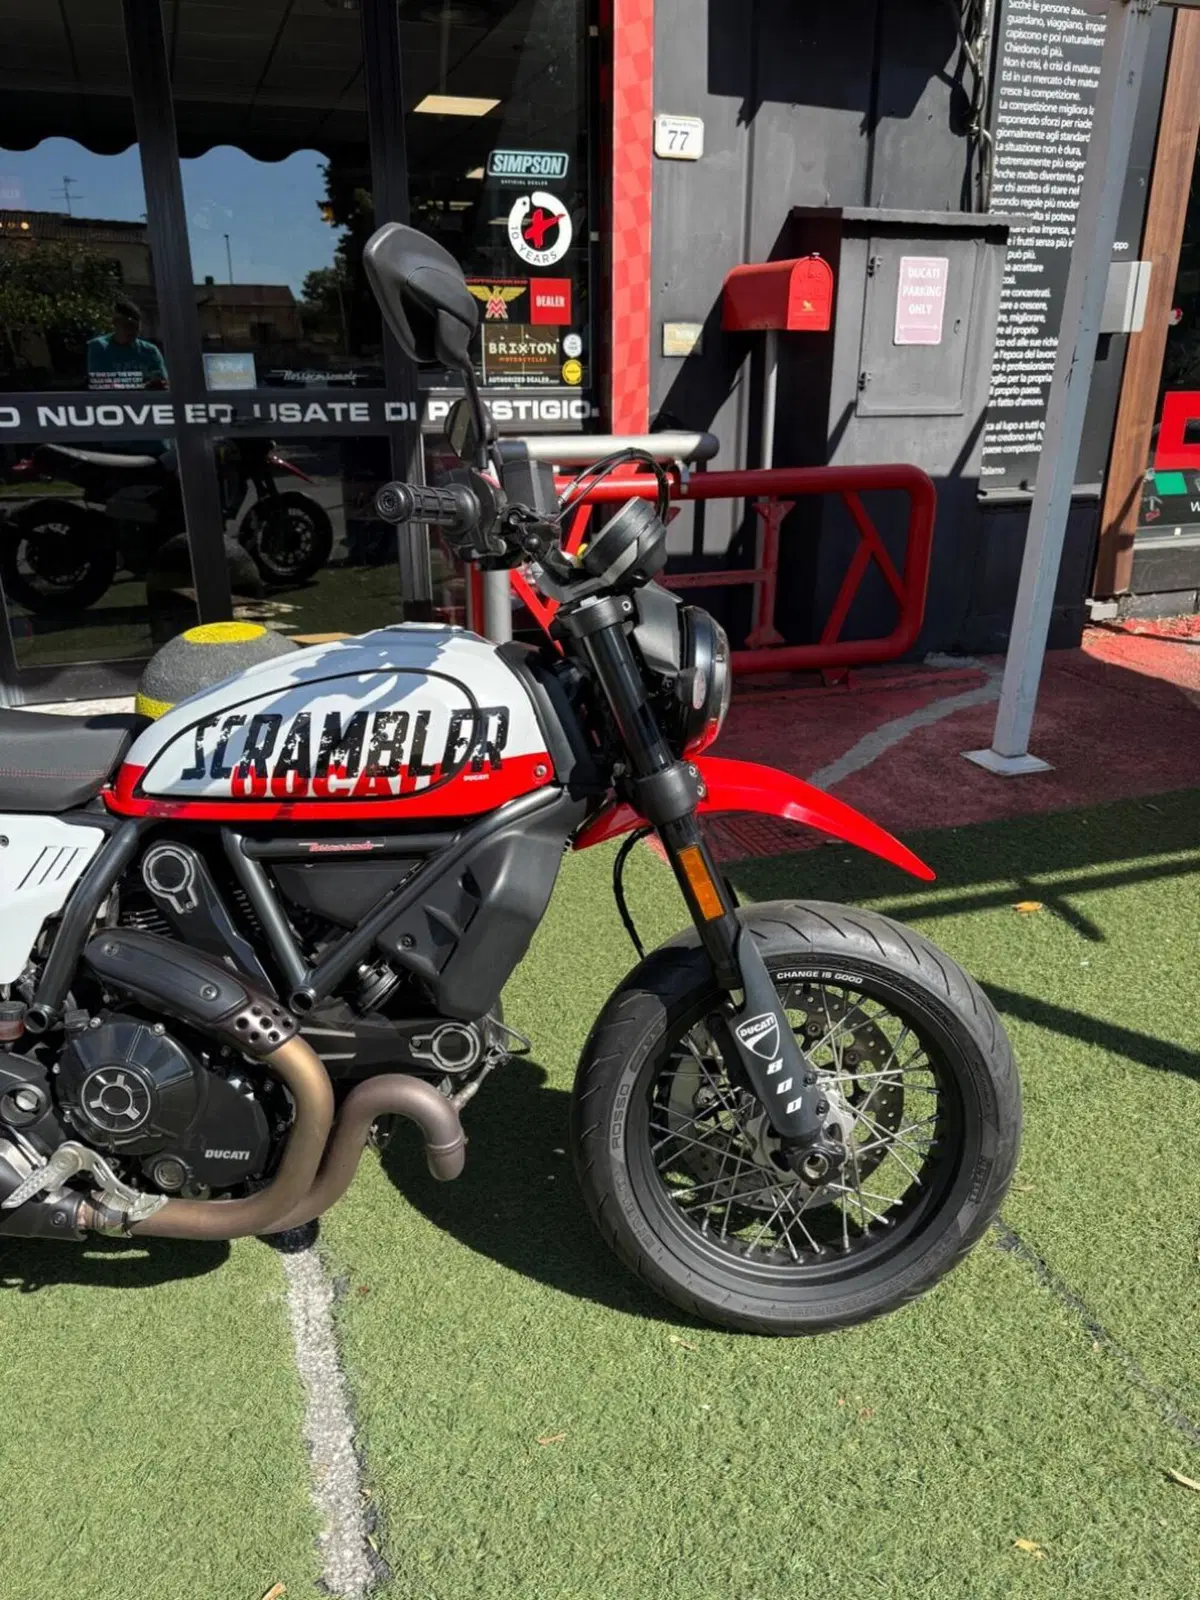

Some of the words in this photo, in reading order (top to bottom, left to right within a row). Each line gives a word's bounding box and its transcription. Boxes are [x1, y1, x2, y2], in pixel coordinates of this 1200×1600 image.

[1032, 1, 1040, 11] le
[1040, 3, 1071, 14] persone
[1005, 28, 1042, 41] capiscono
[1042, 33, 1048, 41] e
[1049, 32, 1061, 44] poi
[1004, 41, 1040, 55] Chiedono
[1041, 44, 1049, 56] di
[1003, 56, 1019, 68] Non
[1049, 60, 1063, 72] crisi
[1063, 61, 1072, 73] di
[1002, 71, 1012, 81] Ed
[1013, 72, 1021, 82] in
[1021, 74, 1032, 83] un
[1033, 75, 1063, 86] mercato
[1063, 76, 1077, 87] che
[1000, 87, 1023, 97] cresce
[1023, 86, 1031, 97] la
[999, 99, 1008, 109] La
[1009, 101, 1058, 112] competizione
[1058, 104, 1088, 116] migliora
[998, 113, 1041, 125] imponendo
[1041, 115, 1060, 127] sforzi
[1061, 119, 1074, 129] per
[668, 130, 690, 151] 77
[996, 127, 1045, 140] giornalmente
[1046, 130, 1060, 142] agli
[995, 141, 1004, 151] La
[1004, 142, 1042, 153] situazione
[1042, 145, 1057, 154] non
[1058, 144, 1063, 154] è
[492, 154, 563, 174] SIMPSON
[1000, 156, 1051, 167] estremamente
[1051, 158, 1064, 169] più
[993, 168, 1016, 178] Anche
[1016, 170, 1039, 180] molto
[1039, 170, 1076, 183] divertente,
[1004, 182, 1016, 193] chi
[1016, 183, 1042, 193] accetta
[1042, 183, 1050, 194] di
[1050, 185, 1068, 195] stare
[1020, 198, 1043, 210] regole
[1043, 198, 1056, 210] più
[1044, 211, 1051, 221] si
[1051, 212, 1076, 223] poteva
[1041, 223, 1070, 236] impresa,
[511, 226, 520, 240] 10
[519, 243, 557, 263] YEARS
[1016, 236, 1035, 246] frutti
[1035, 238, 1055, 247] senza
[1055, 237, 1068, 249] più
[907, 267, 940, 279] DUCATI
[1012, 263, 1044, 273] accettare
[902, 285, 942, 297] PARKING
[535, 295, 565, 308] DEALER
[1013, 302, 1019, 310] a
[908, 303, 932, 315] ONLY
[1005, 325, 1012, 335] al
[1012, 325, 1040, 336] proprio
[1006, 337, 1016, 347] ed
[1016, 336, 1029, 347] alle
[1029, 338, 1042, 347] sue
[488, 342, 557, 355] BRIXTON
[1024, 348, 1036, 359] del
[1007, 375, 1020, 384] per
[1020, 373, 1027, 383] la
[994, 385, 1020, 397] proprio
[997, 397, 1015, 407] fatto
[37, 404, 175, 427] NUOVE
[385, 402, 417, 422] DI
[428, 399, 600, 422] PSTIGIO.
[995, 421, 1002, 431] al
[1002, 420, 1018, 432] lupo
[1018, 422, 1024, 430] a
[1024, 420, 1040, 430] tutti
[997, 432, 1025, 442] credono
[1025, 431, 1036, 441] nel
[1002, 443, 1042, 455] competitivo
[181, 705, 510, 780] SCRAMBLER
[776, 970, 820, 979] CHANGE
[821, 971, 832, 979] IS
[834, 972, 863, 984] GOOD
[740, 1016, 775, 1037] DUCATI
[611, 1083, 631, 1151] ROSSO
[204, 1149, 250, 1161] DUCATI
